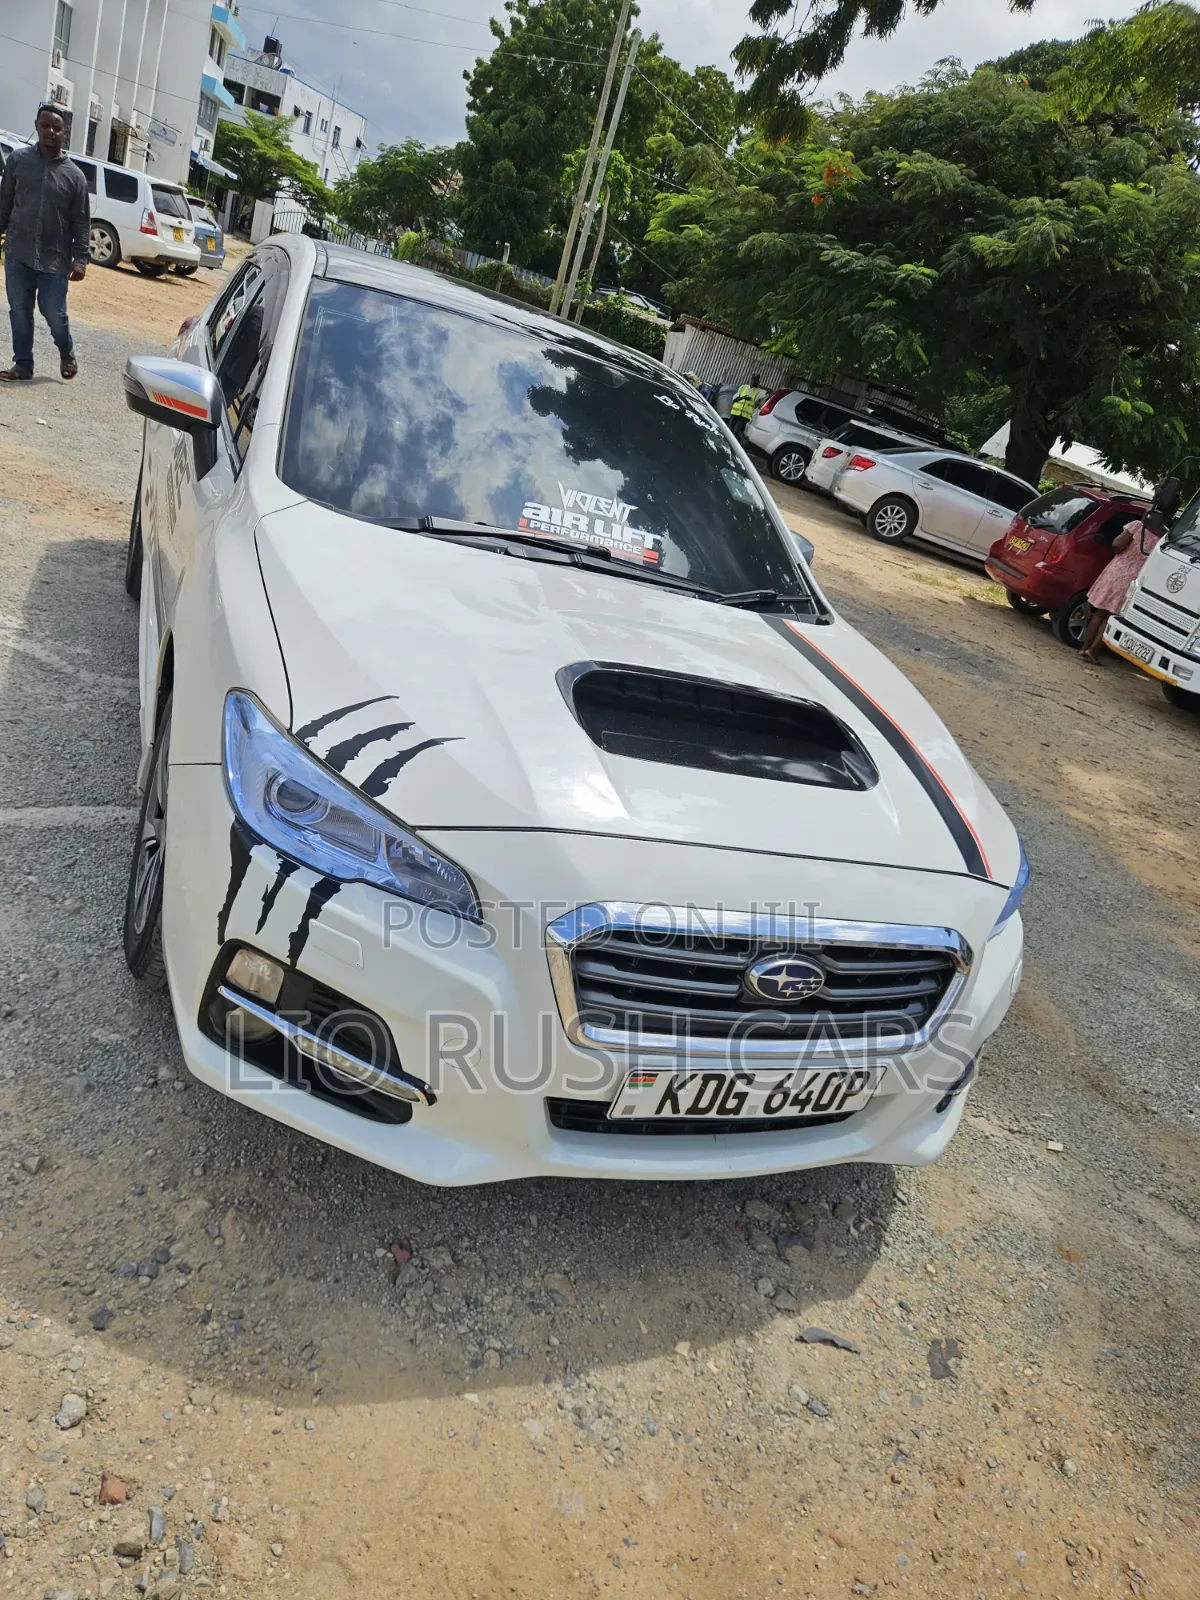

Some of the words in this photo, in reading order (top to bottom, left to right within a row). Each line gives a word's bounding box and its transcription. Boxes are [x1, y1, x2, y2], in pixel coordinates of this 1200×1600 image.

[558, 481, 638, 523] VIOLENT
[654, 1073, 755, 1116] KDG
[763, 1071, 871, 1115] 640P
